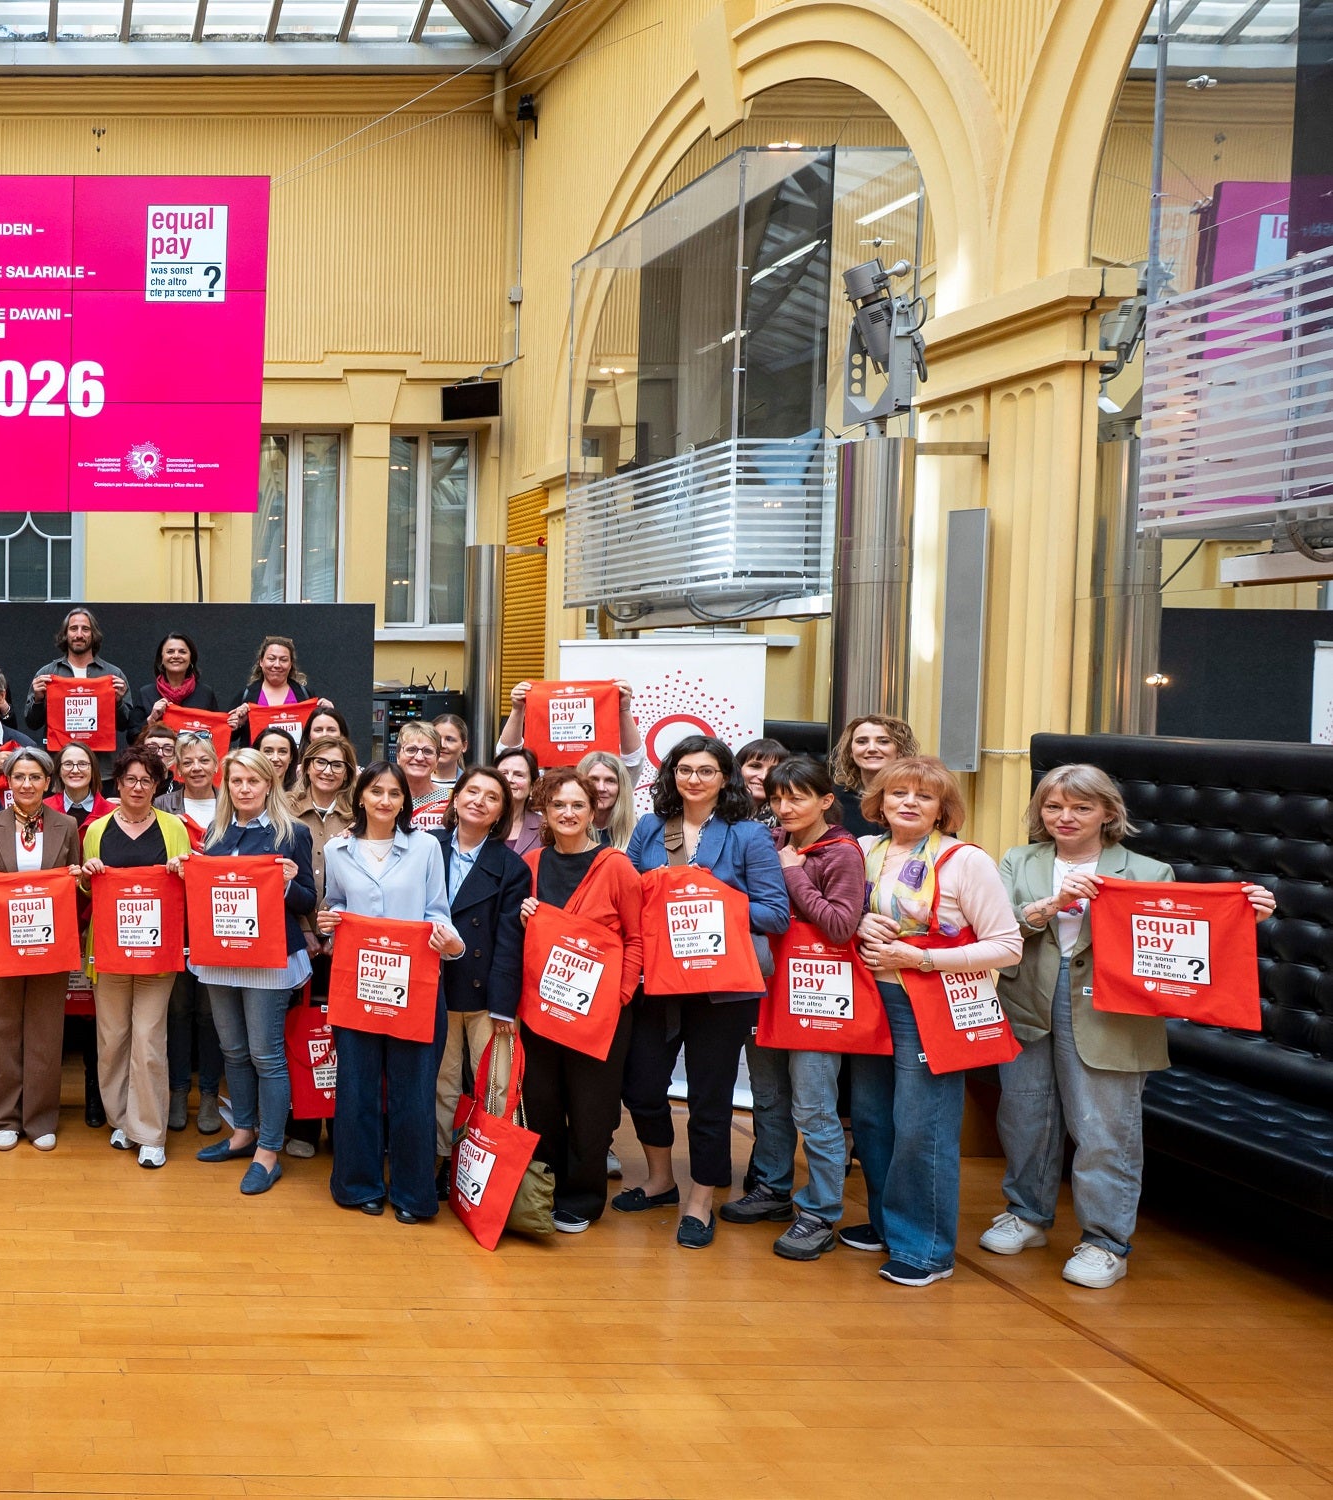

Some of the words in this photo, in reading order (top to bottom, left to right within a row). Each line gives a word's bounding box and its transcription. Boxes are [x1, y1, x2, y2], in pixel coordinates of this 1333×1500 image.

[152, 208, 213, 234] equal
[151, 237, 192, 259] pay
[6, 266, 84, 278] SALARIALE
[170, 266, 193, 274] sonst
[150, 277, 165, 285] che
[150, 289, 162, 297] cie
[165, 290, 175, 298] pa
[9, 308, 61, 320] DAVANI
[66, 697, 92, 707] equal
[551, 698, 586, 711] equal
[66, 707, 83, 716] pay
[552, 712, 574, 723] pay
[214, 888, 249, 902] equal
[11, 898, 45, 913] equal
[119, 900, 153, 914] equal
[214, 903, 237, 915] pay
[670, 900, 712, 918] equal
[11, 913, 34, 926] pay
[119, 914, 142, 926] pay
[671, 918, 698, 933] pay
[1136, 919, 1194, 935] equal
[1136, 935, 1174, 952] pay
[361, 953, 401, 968] equal
[552, 950, 594, 973] equal
[1155, 955, 1176, 963] sonst
[360, 966, 386, 981] pay
[547, 963, 575, 982] pay
[792, 962, 841, 976] equal
[792, 976, 824, 991] pay
[949, 986, 977, 1003] pay
[460, 1141, 487, 1164] equal
[459, 1154, 472, 1172] pay
